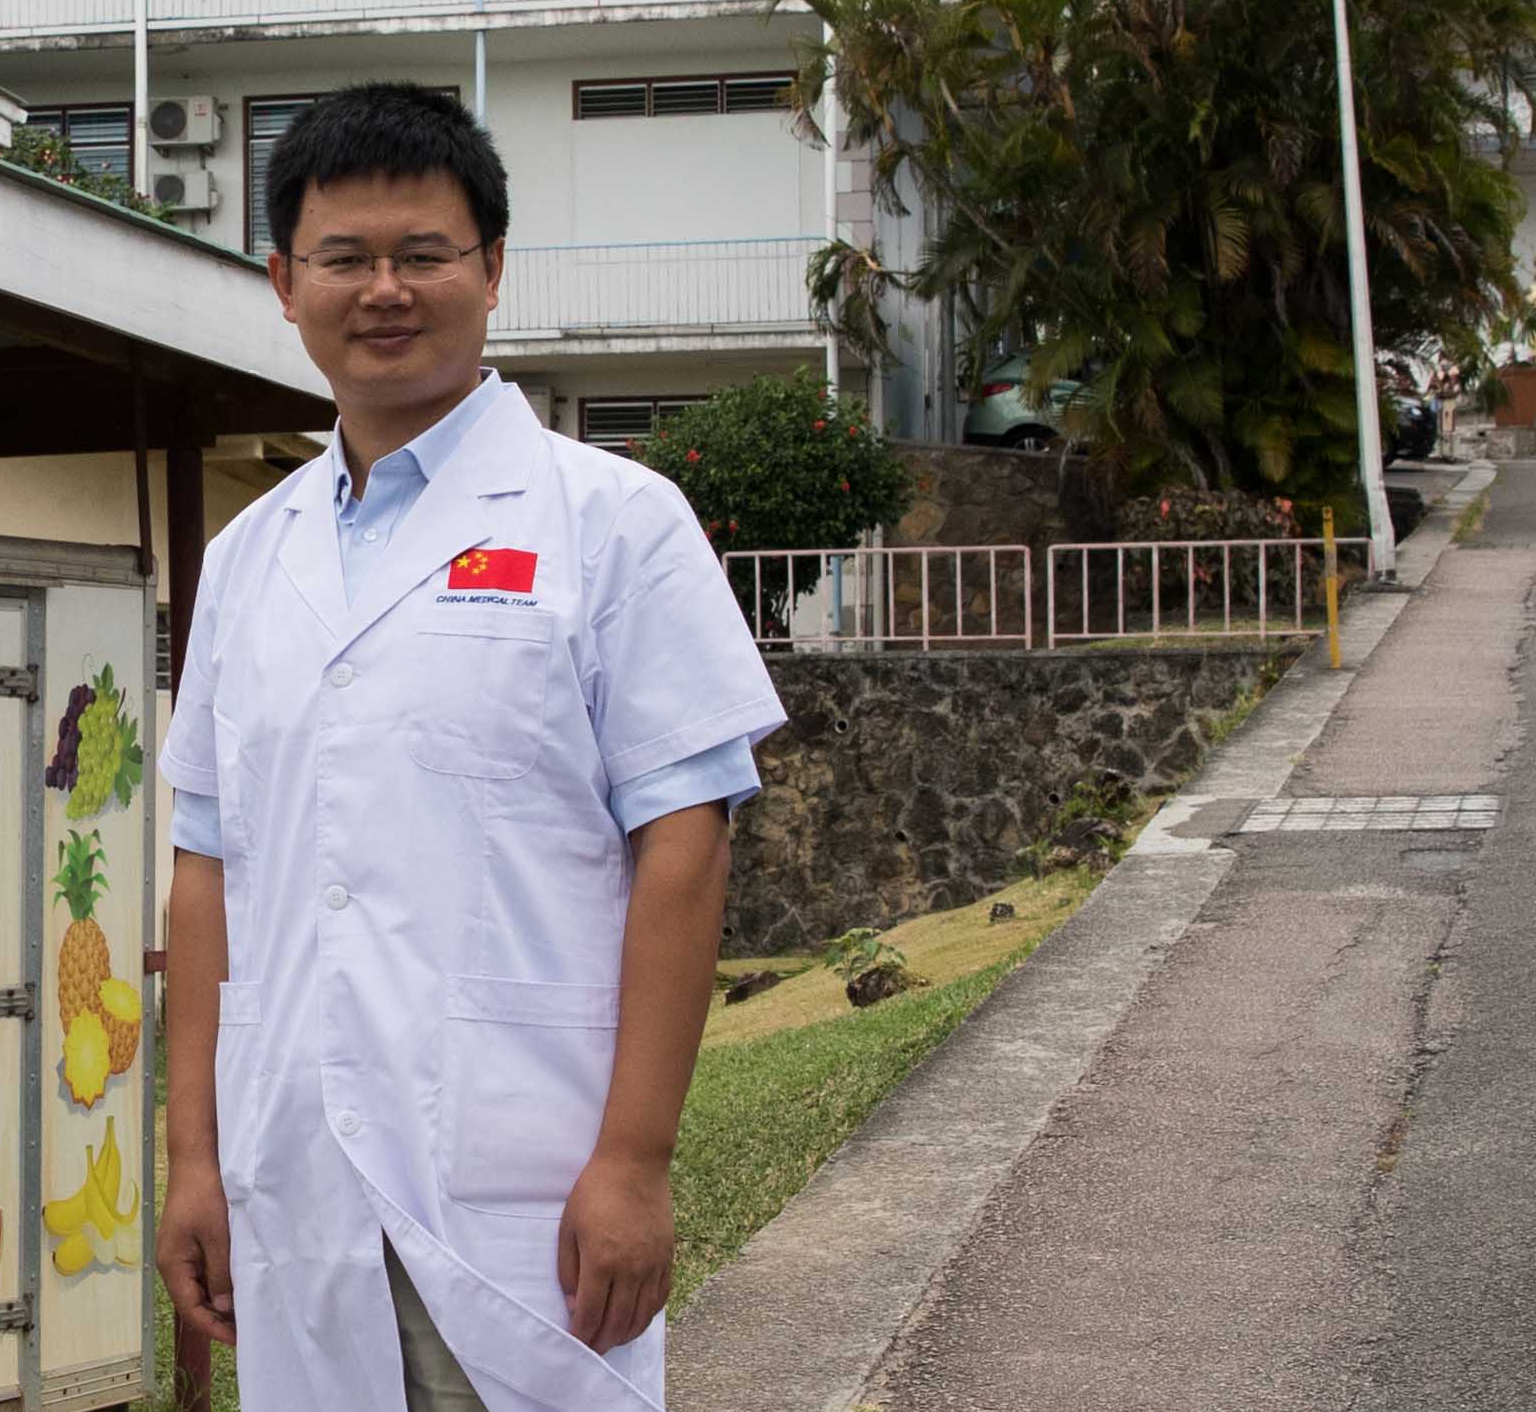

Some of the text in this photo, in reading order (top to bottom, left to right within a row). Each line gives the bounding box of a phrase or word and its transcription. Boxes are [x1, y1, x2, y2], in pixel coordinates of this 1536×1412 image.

[435, 595, 538, 607] CHINA MEDICAL TEAM
